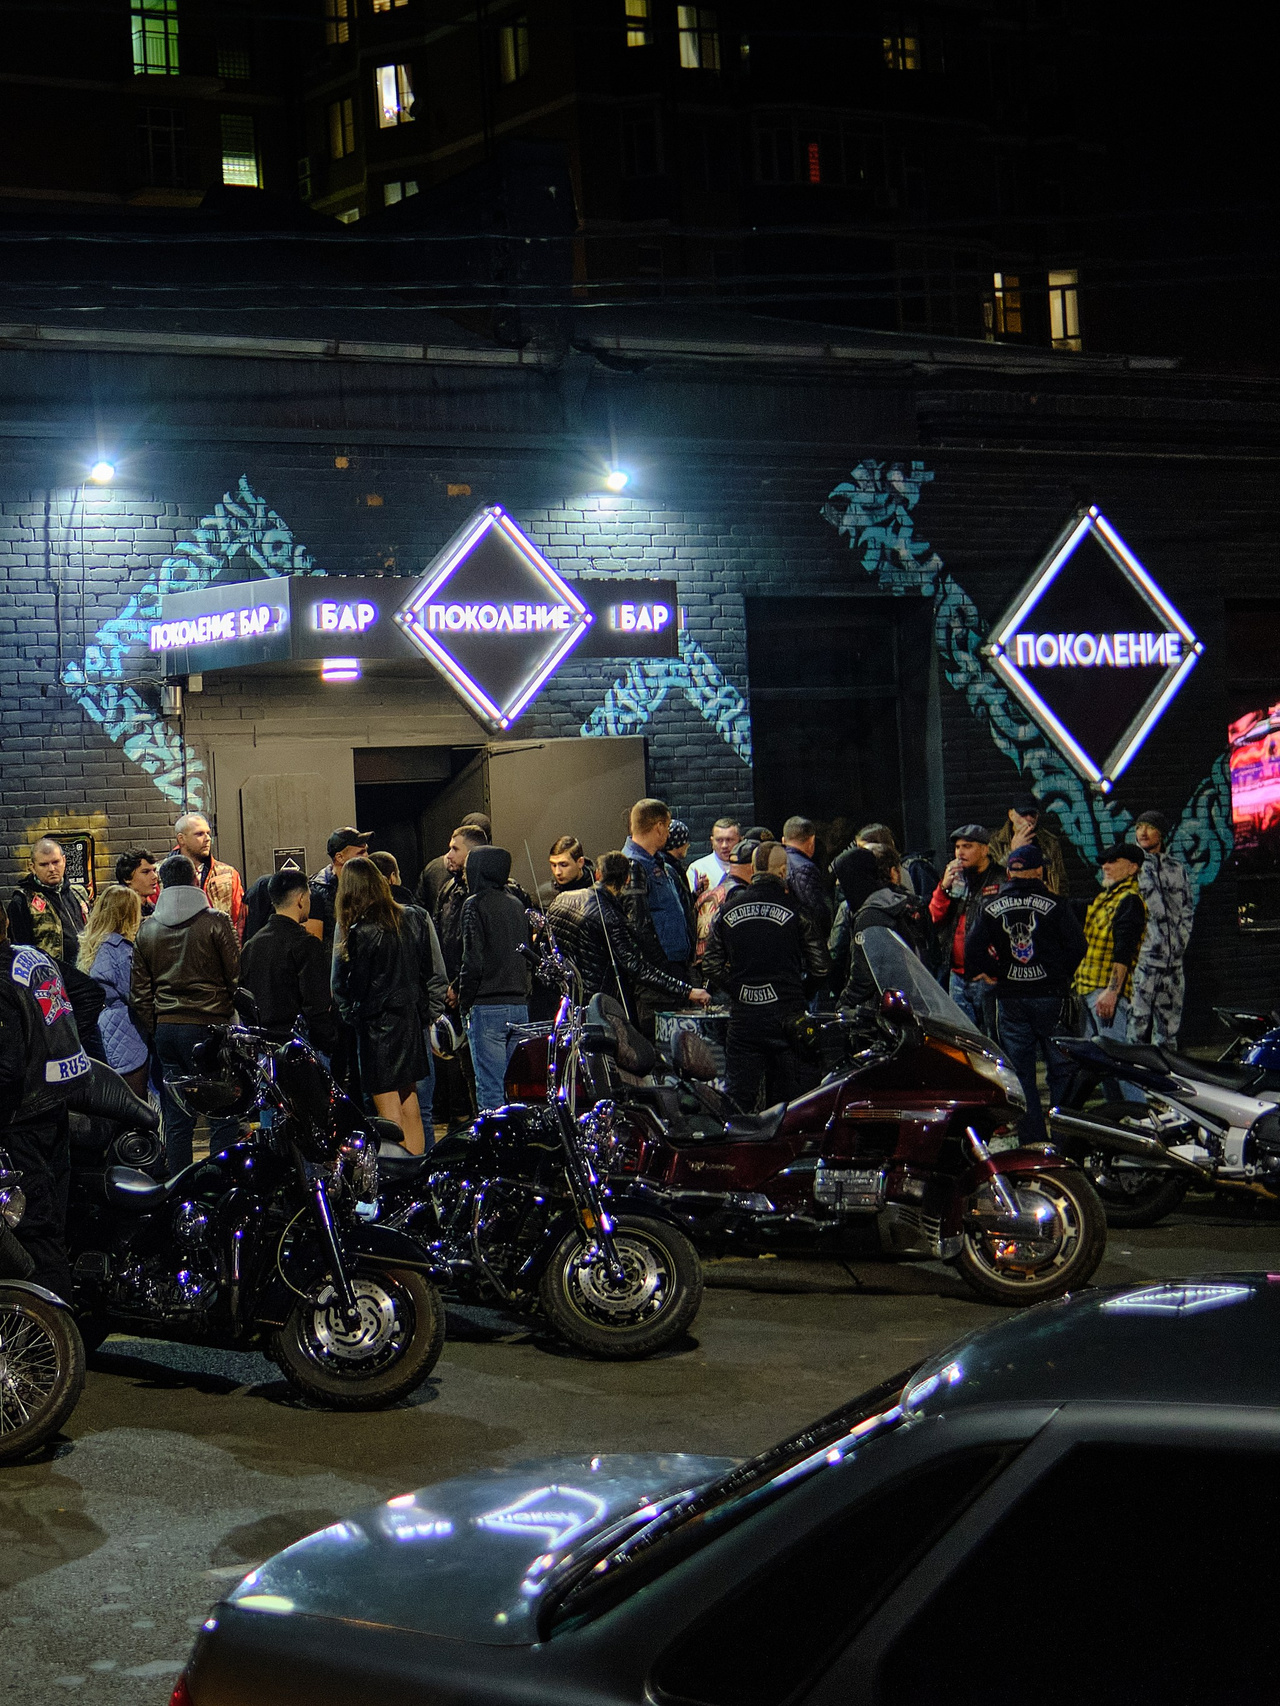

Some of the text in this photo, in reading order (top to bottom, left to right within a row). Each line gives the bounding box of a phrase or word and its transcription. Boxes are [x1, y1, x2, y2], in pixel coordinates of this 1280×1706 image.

[151, 605, 271, 650] ПОКОЛЕНИЕ БАР
[322, 603, 670, 631] БАР ПОКОЛЕНИЕ БАР
[1016, 632, 1183, 669] ПОКОЛЕНИЕ
[726, 904, 790, 925] SOLDIERS OF ODIN
[990, 896, 1022, 915] SOLDIERS
[1032, 898, 1052, 912] ODIN
[1012, 965, 1043, 978] RUSSIA
[742, 987, 775, 1002] RUSSIA
[58, 1054, 88, 1079] RUS
